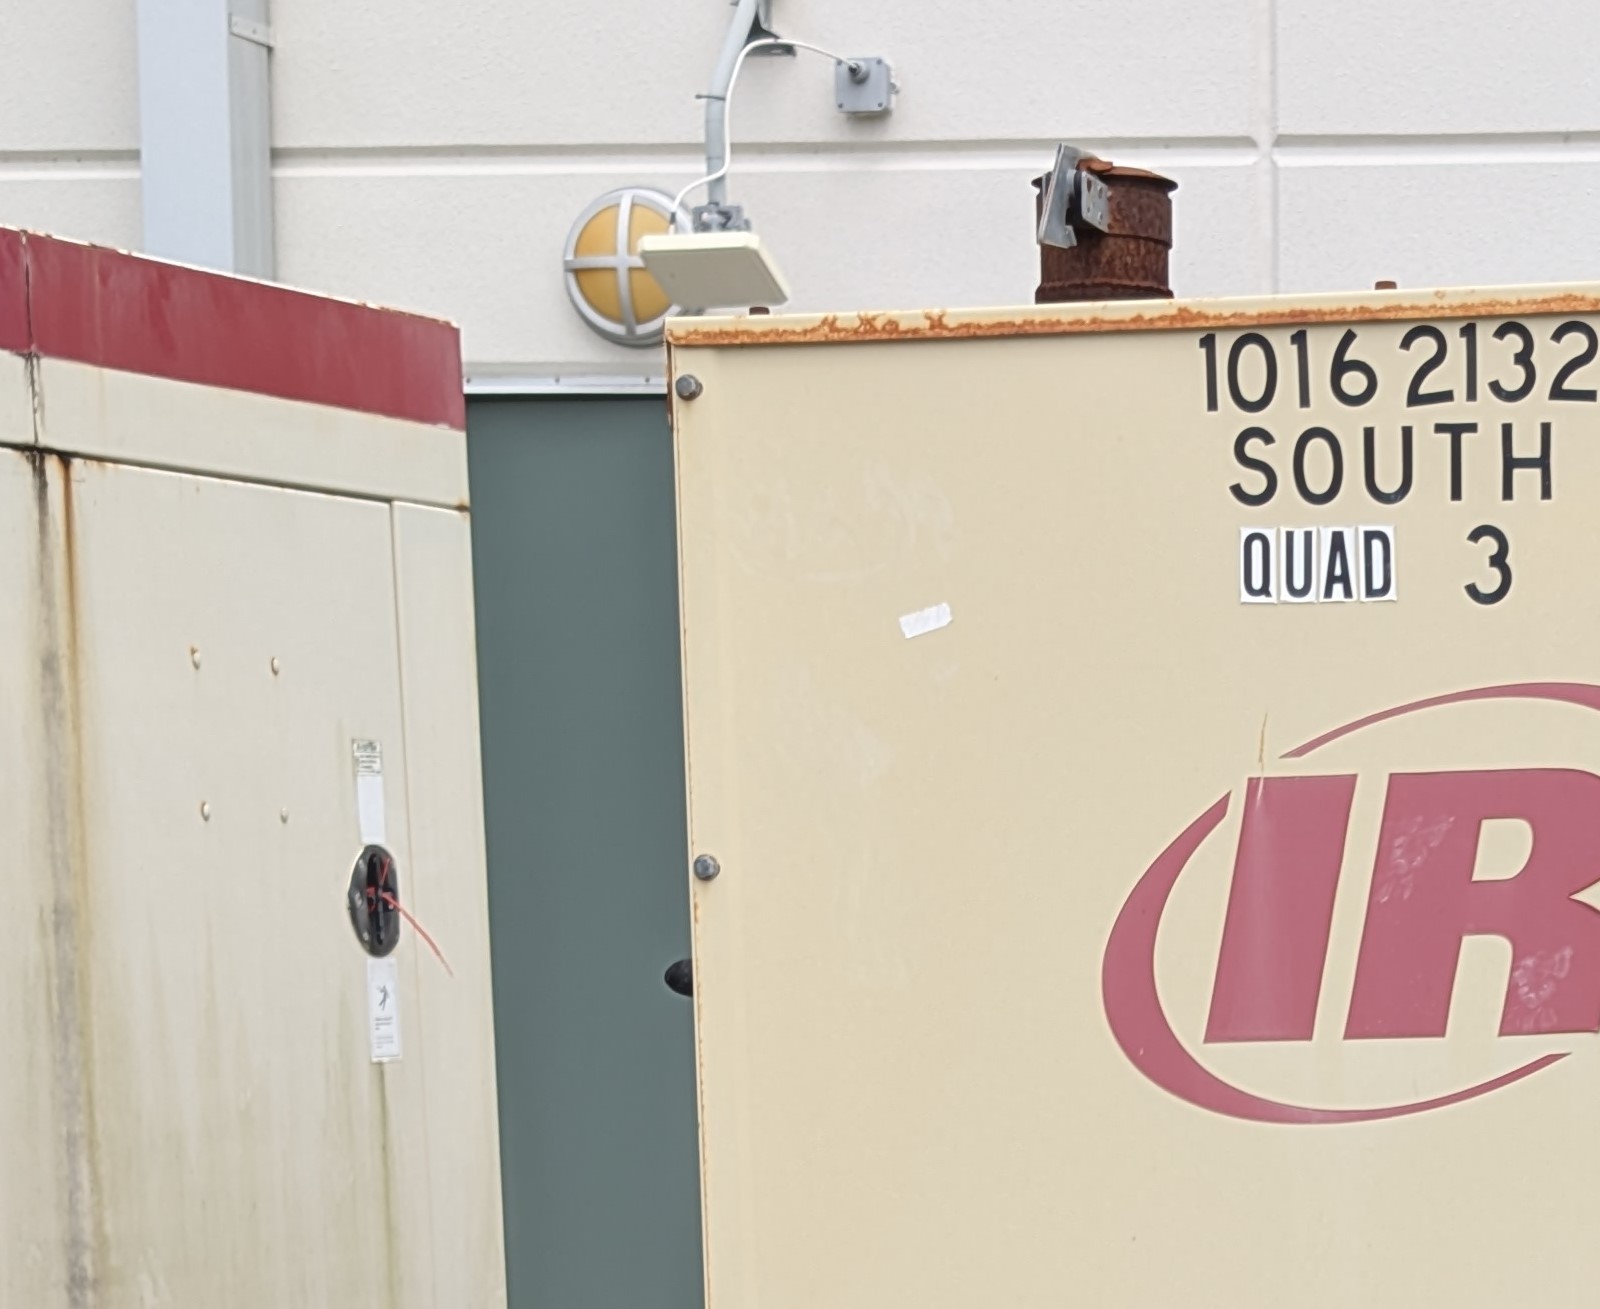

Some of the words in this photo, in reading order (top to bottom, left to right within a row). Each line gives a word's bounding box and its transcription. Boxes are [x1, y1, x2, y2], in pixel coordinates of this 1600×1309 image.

[1229, 422, 1552, 506] SOUTH
[1242, 529, 1392, 599] QUAD
[1464, 524, 1513, 605] 3
